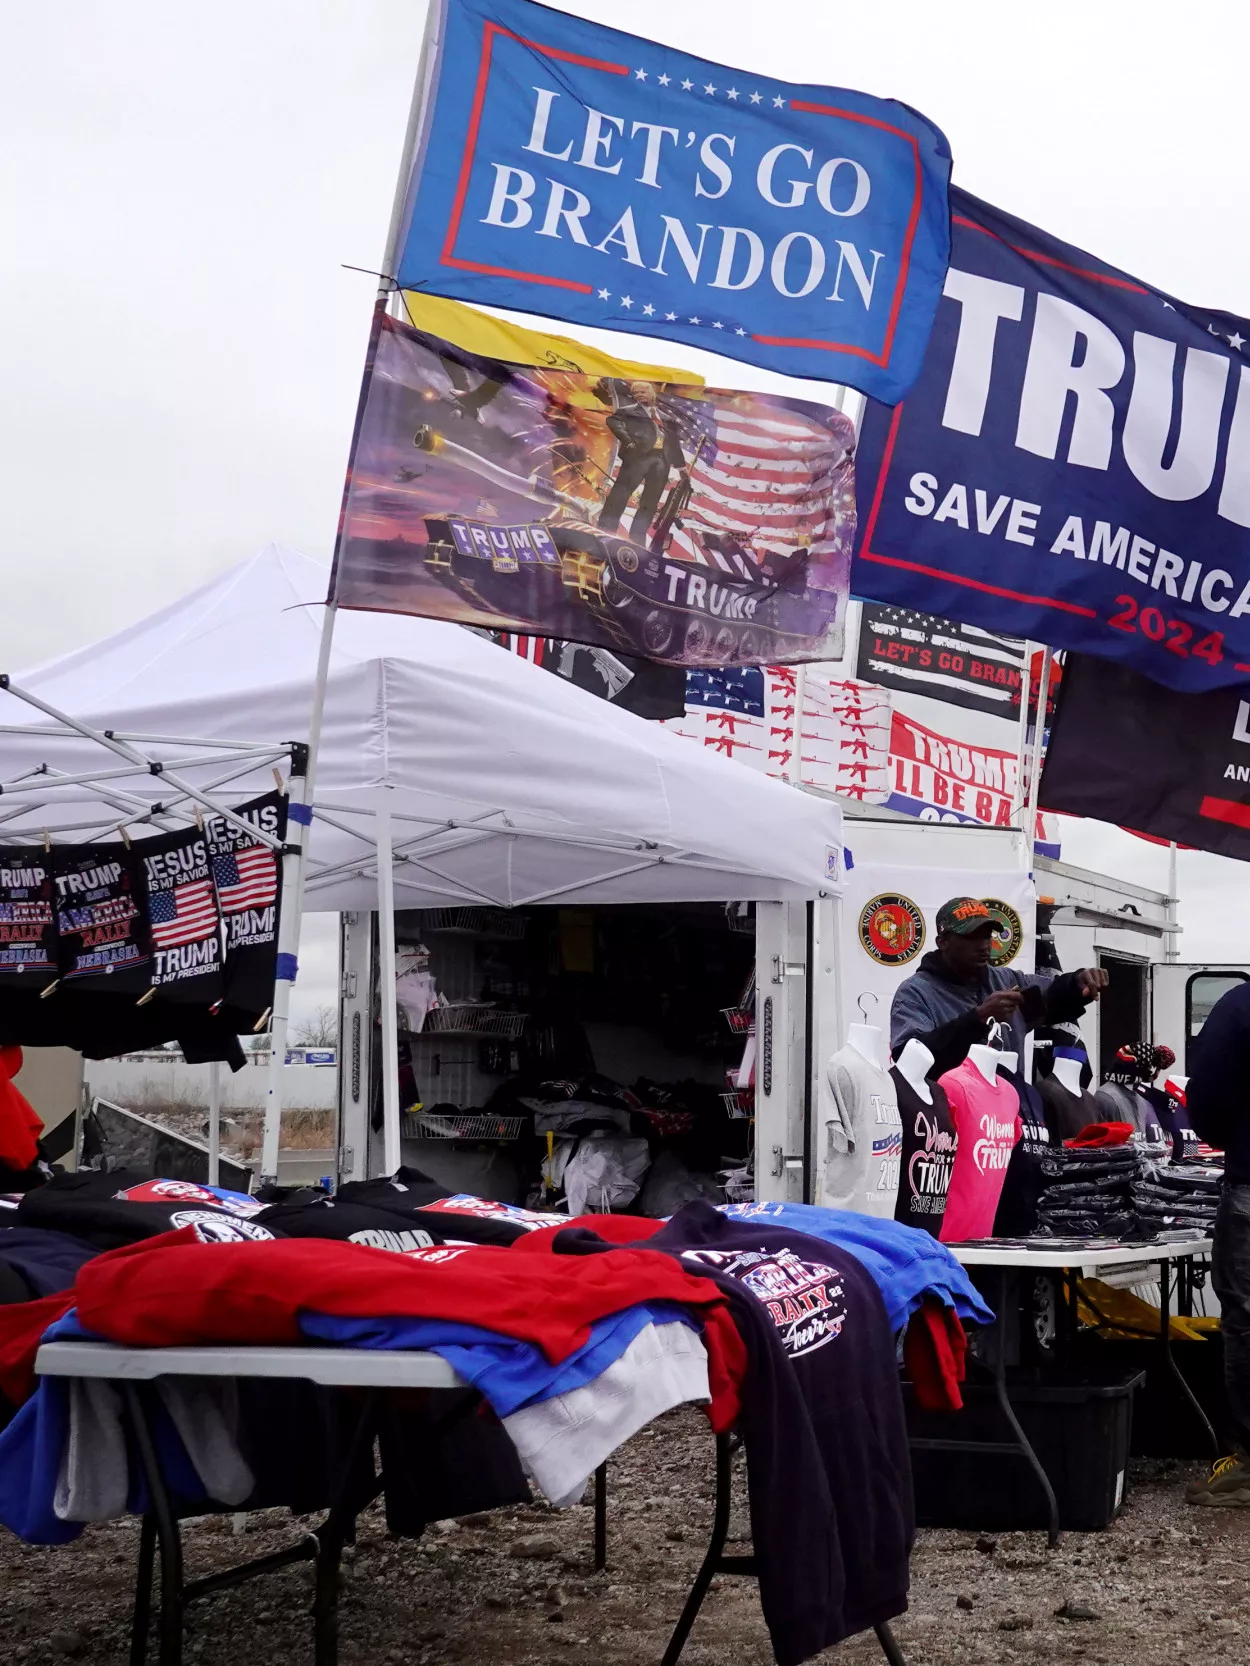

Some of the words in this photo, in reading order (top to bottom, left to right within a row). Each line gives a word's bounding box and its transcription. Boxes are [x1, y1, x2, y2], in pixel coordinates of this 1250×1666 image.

[521, 86, 736, 200] LET'S
[756, 143, 872, 218] GO
[479, 162, 886, 312] BRANDON
[903, 472, 1042, 547] SAVE
[452, 524, 551, 549] TRUMP
[664, 564, 759, 620] TRUMP
[1107, 594, 1225, 667] 2024
[873, 638, 932, 667] LET'S
[938, 652, 965, 673] GO
[969, 661, 1055, 698] BRANO
[888, 756, 924, 798] 'LL
[933, 771, 966, 811] BE
[237, 830, 278, 850] SAVR
[143, 839, 207, 881] JESUS
[0, 867, 46, 888] RUMP
[55, 862, 122, 896] TRUMP
[148, 878, 159, 892] IS
[160, 875, 174, 890] MY
[176, 863, 210, 887] SAVIOR
[0, 900, 54, 922] MERICA
[862, 899, 883, 929] MARINE
[897, 898, 922, 929] UNITED
[952, 902, 991, 921] TRUM
[1001, 905, 1020, 934] UNITED
[0, 924, 44, 942] RALLY
[80, 919, 132, 948] RALLY
[236, 931, 275, 946] PRESIDEN
[863, 935, 883, 960] CORPS
[0, 948, 48, 963] EBRASKA
[76, 943, 140, 970] NEBRASKA
[153, 937, 219, 975] TRUMP
[897, 935, 922, 961] STATES
[151, 972, 161, 985] IS
[162, 969, 175, 984] MY
[177, 961, 221, 980] PRESIDENT
[1104, 1072, 1132, 1085] SAVE
[870, 1094, 903, 1125] Trum
[914, 1111, 959, 1153] Wome
[979, 1113, 1015, 1140] Wome
[1021, 1124, 1050, 1143] RUM
[935, 1154, 946, 1164] FOR
[918, 1161, 953, 1195] TRUM
[766, 1284, 833, 1327] RALLY
